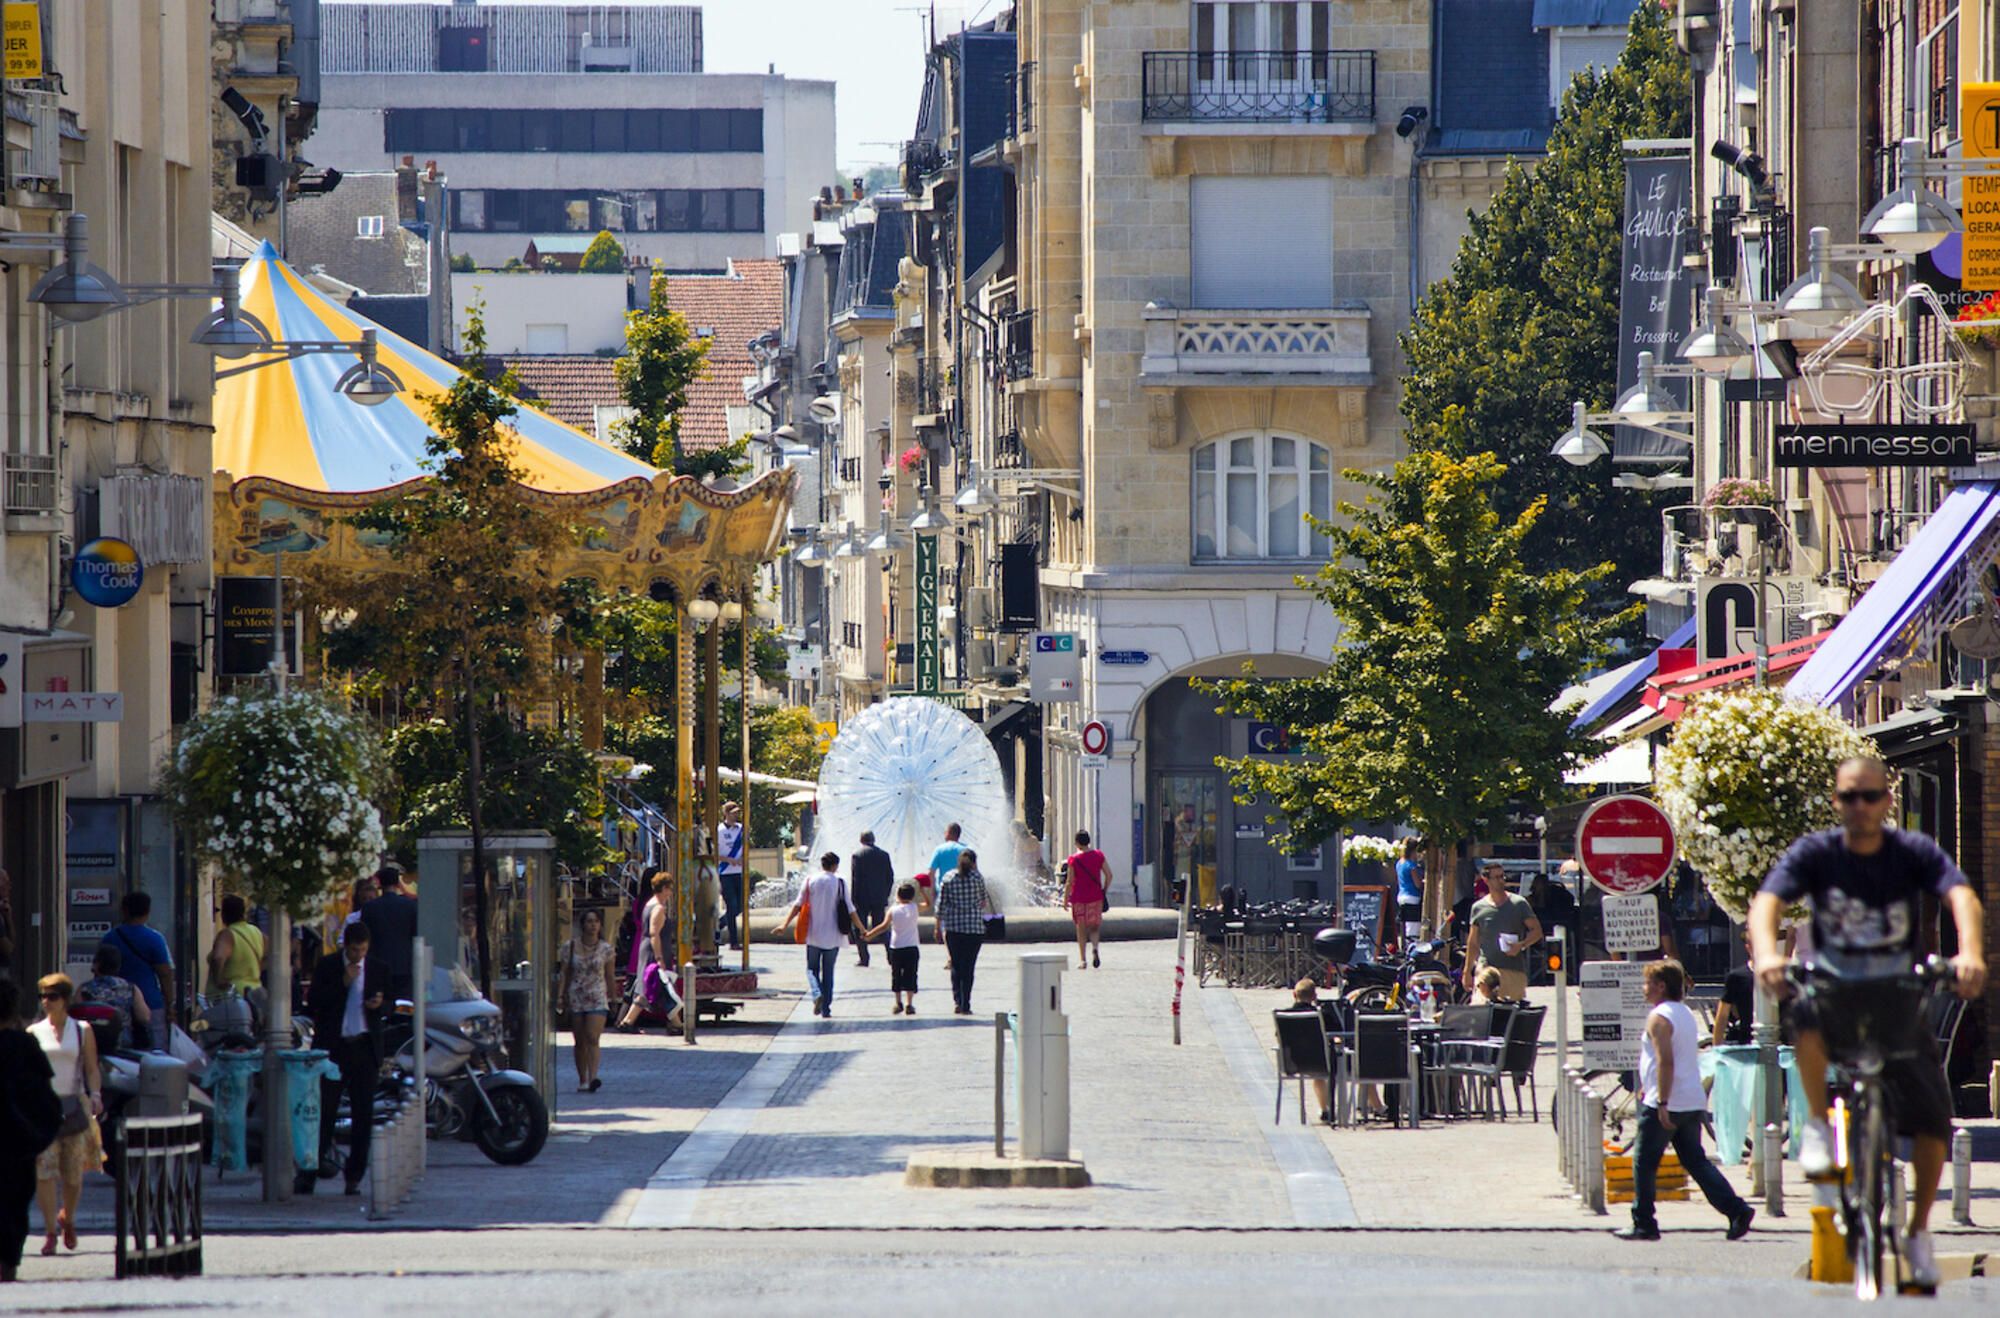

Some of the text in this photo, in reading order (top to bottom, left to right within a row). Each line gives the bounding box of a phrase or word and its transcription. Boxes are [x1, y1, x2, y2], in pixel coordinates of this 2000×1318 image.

[10, 60, 38, 69] 99 99
[1648, 174, 1667, 201] LE
[1630, 264, 1682, 282] Restaurant
[1649, 295, 1667, 312] Bar
[1633, 326, 1680, 343] Brasserie
[1777, 435, 1972, 456] mennesson
[76, 560, 138, 575] Thomas
[100, 574, 138, 589] Cook
[919, 541, 935, 692] VIGNERAIE
[34, 697, 117, 710] MATY
[1608, 939, 1657, 948] MUNICIPAL
